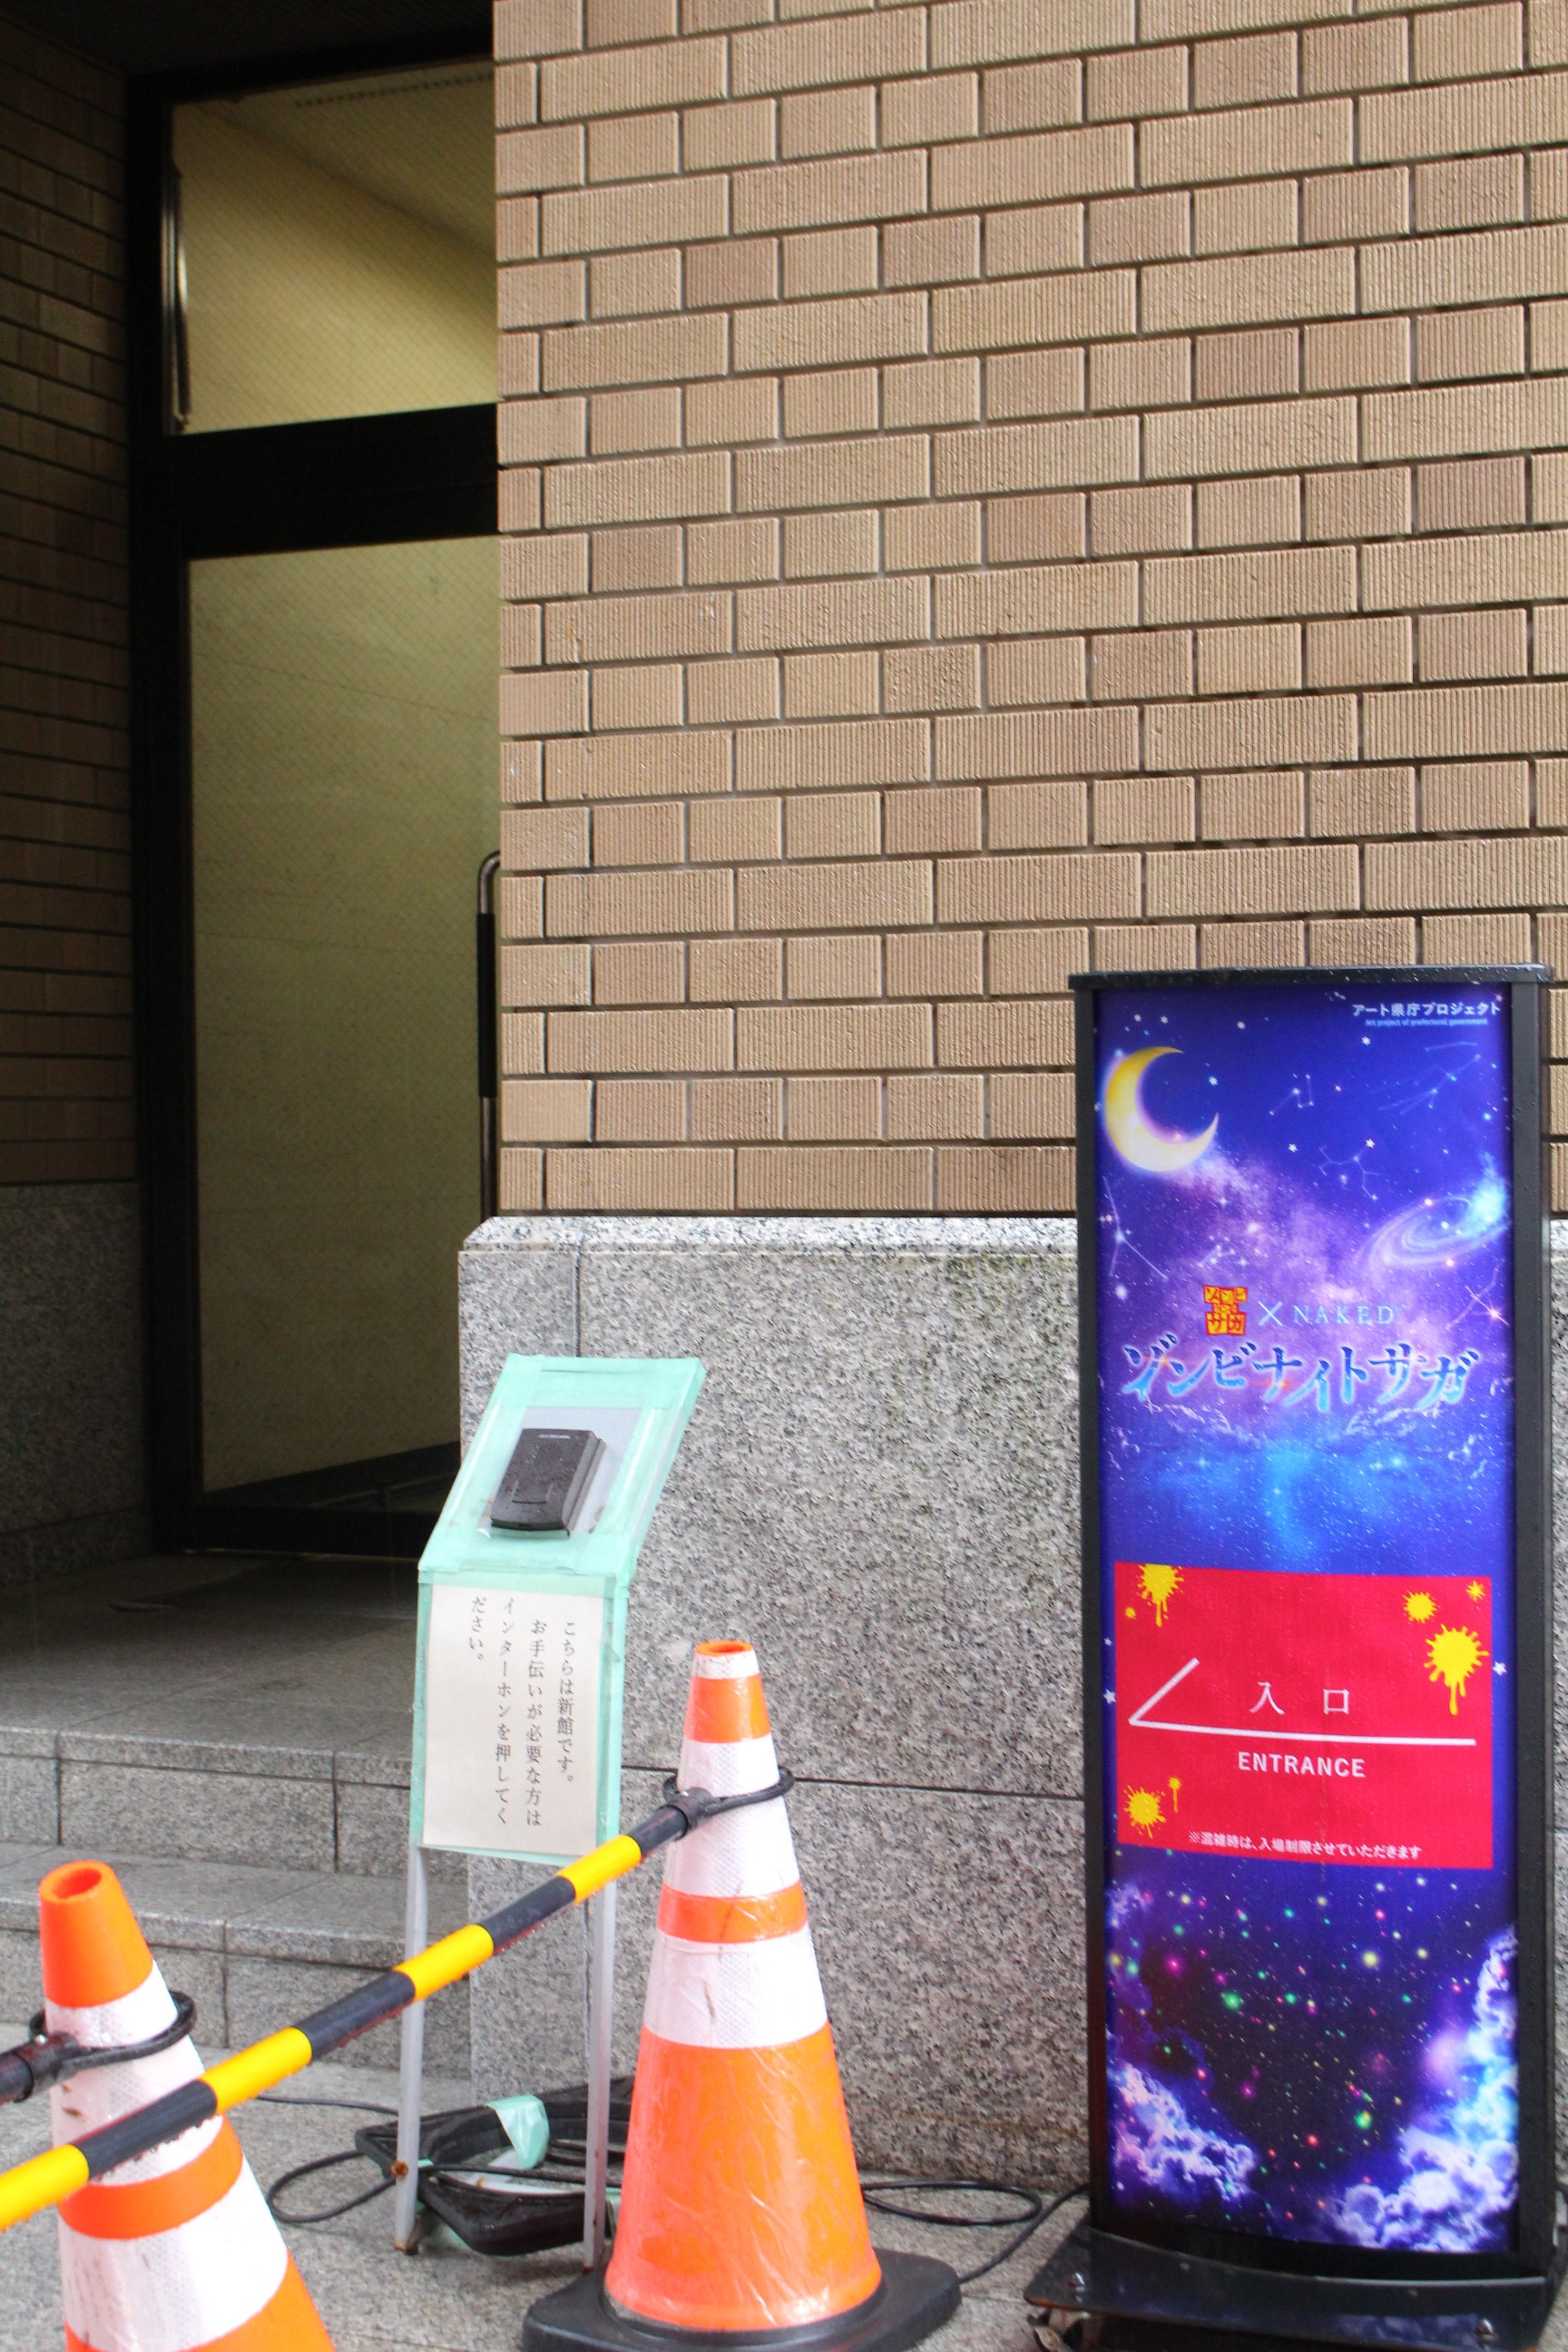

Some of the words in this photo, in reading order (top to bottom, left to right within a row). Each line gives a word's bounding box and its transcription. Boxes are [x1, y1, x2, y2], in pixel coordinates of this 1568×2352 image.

[1352, 1002, 1501, 1016] アート県庁プロジェクト
[1292, 1305, 1395, 1325] NAKED
[1122, 1332, 1481, 1412] ゾンビナイトサガ
[468, 1595, 488, 1661] ださい。
[495, 1597, 515, 1826] インターホンを押してく
[524, 1618, 548, 1827] お手伝いが必要な方は
[556, 1621, 576, 1783] こちらは新館です。
[1237, 1750, 1367, 1779] ENTRANCE
